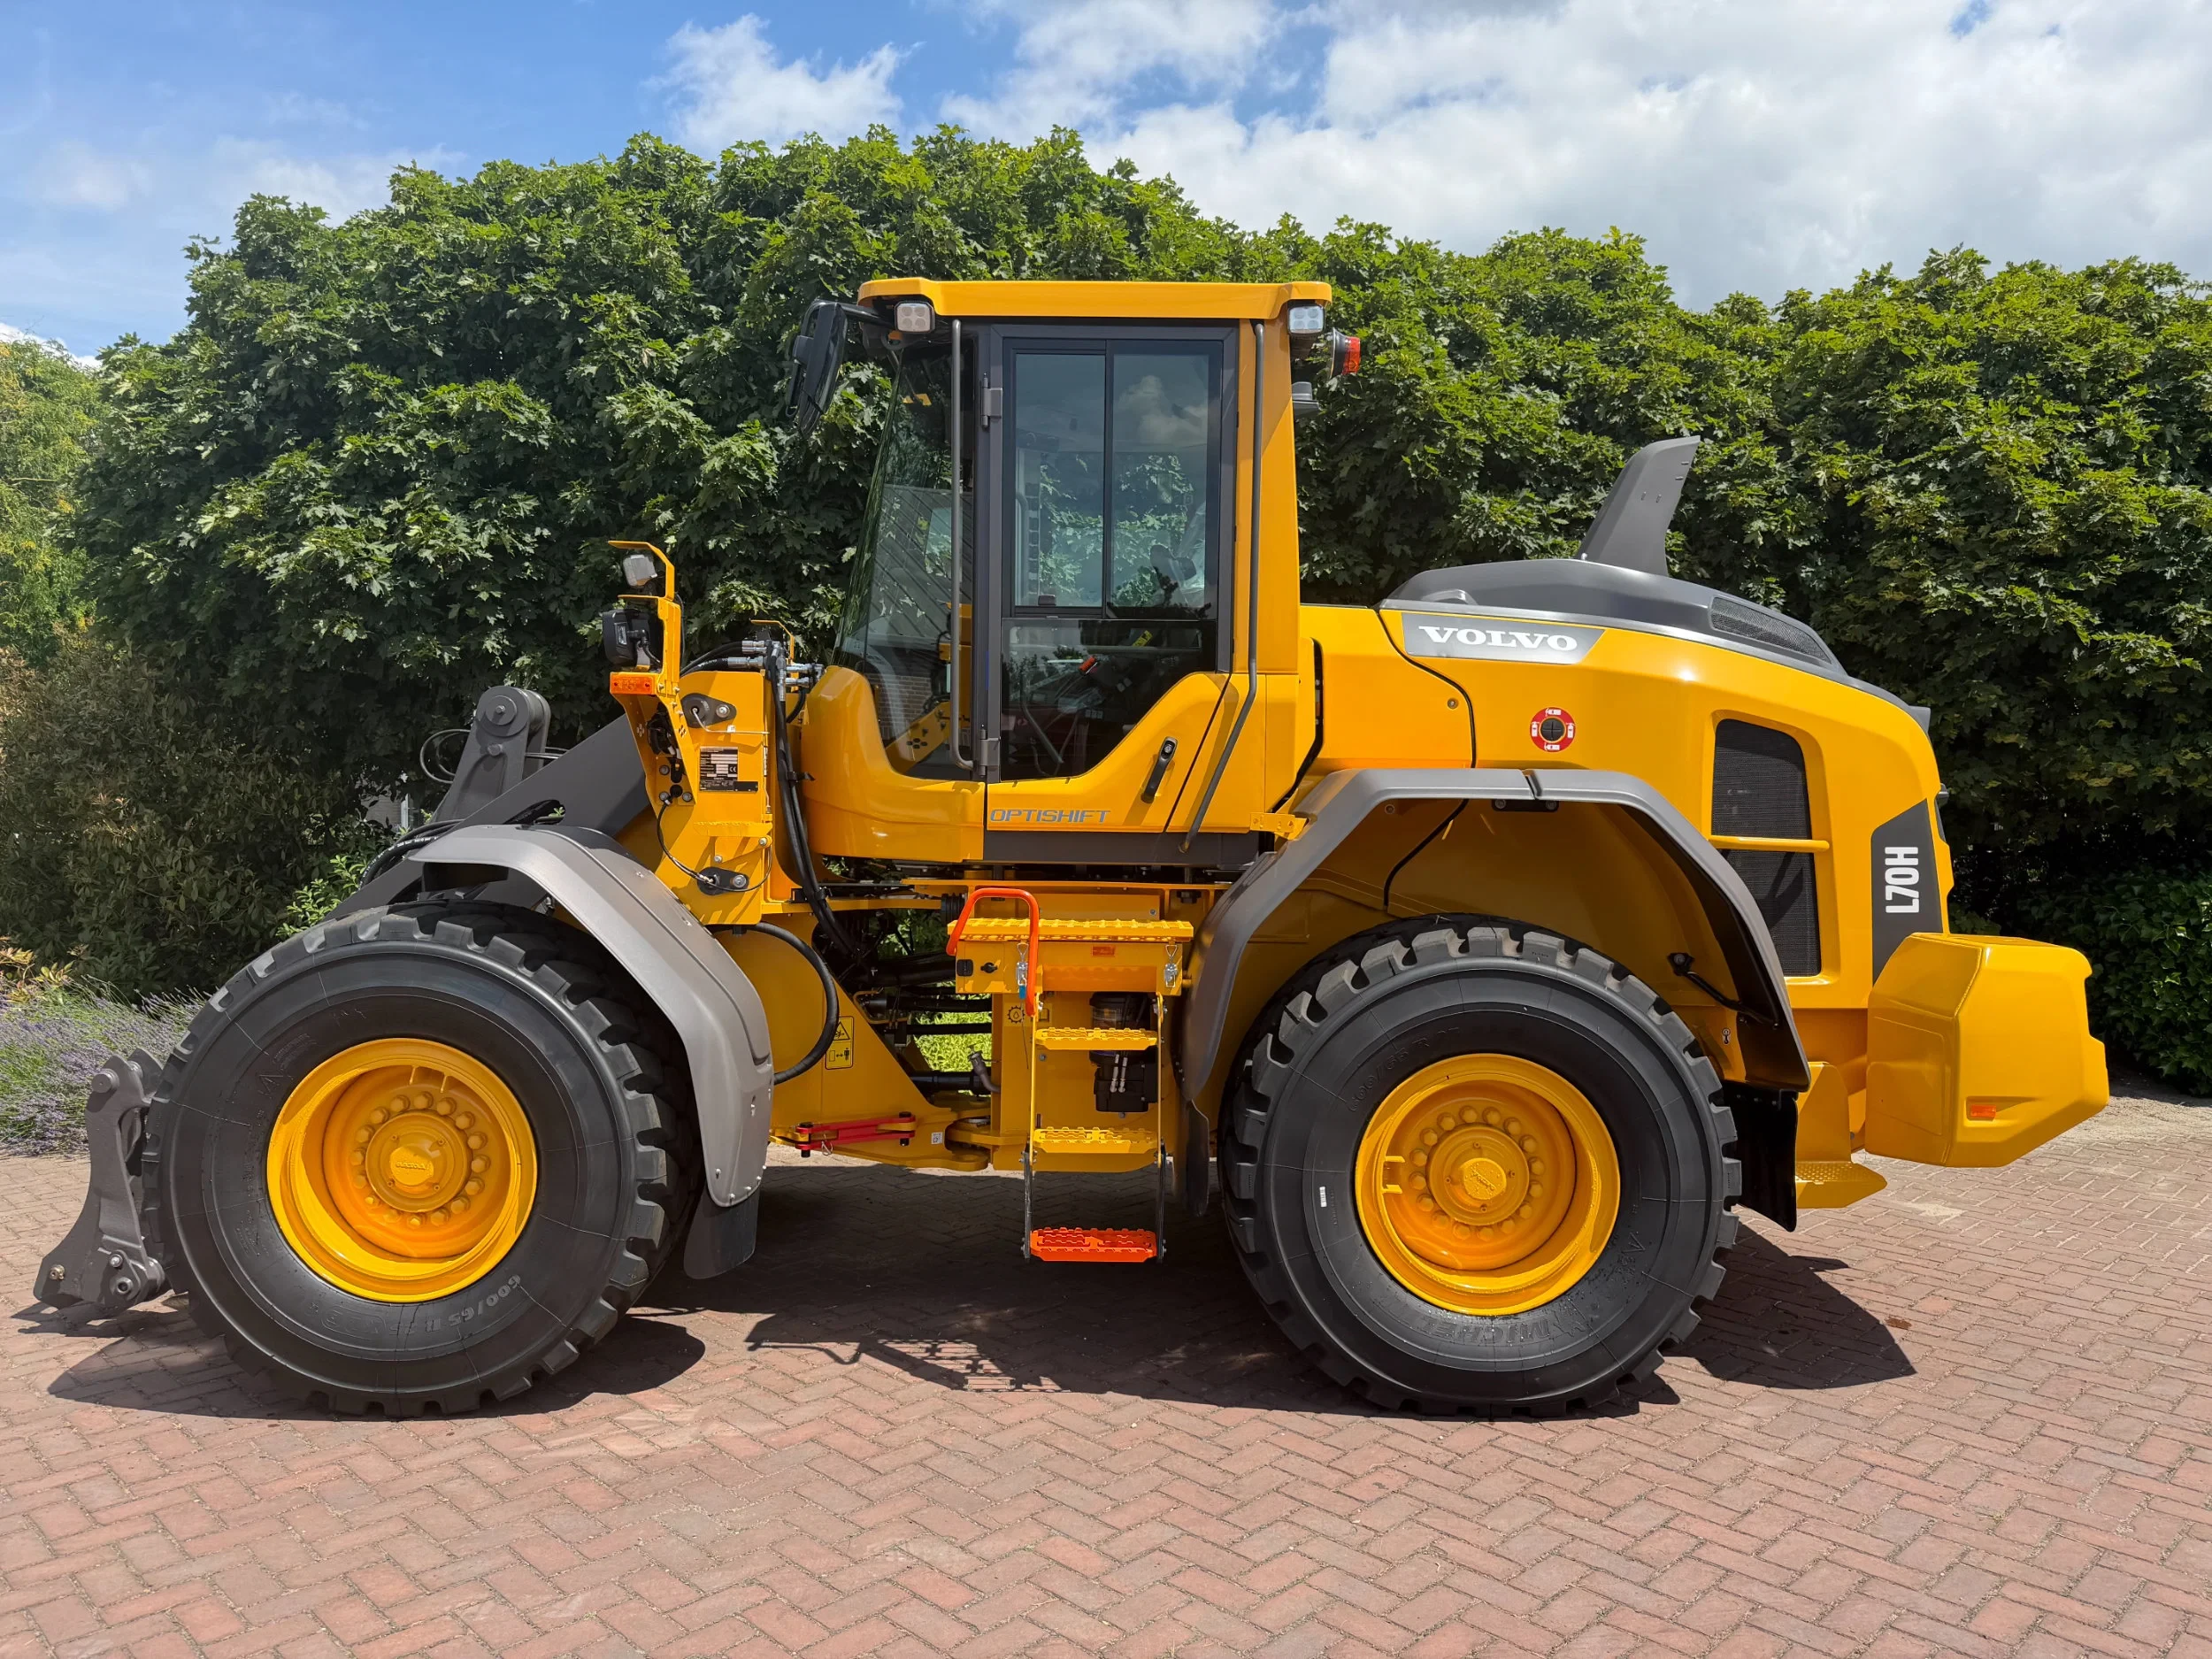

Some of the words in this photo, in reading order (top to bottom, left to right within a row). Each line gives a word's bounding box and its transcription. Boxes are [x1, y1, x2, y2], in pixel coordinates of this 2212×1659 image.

[1418, 626, 1578, 651] VOLVO
[990, 809, 1111, 823] OPTISHIFT
[1885, 847, 1919, 913] L70H
